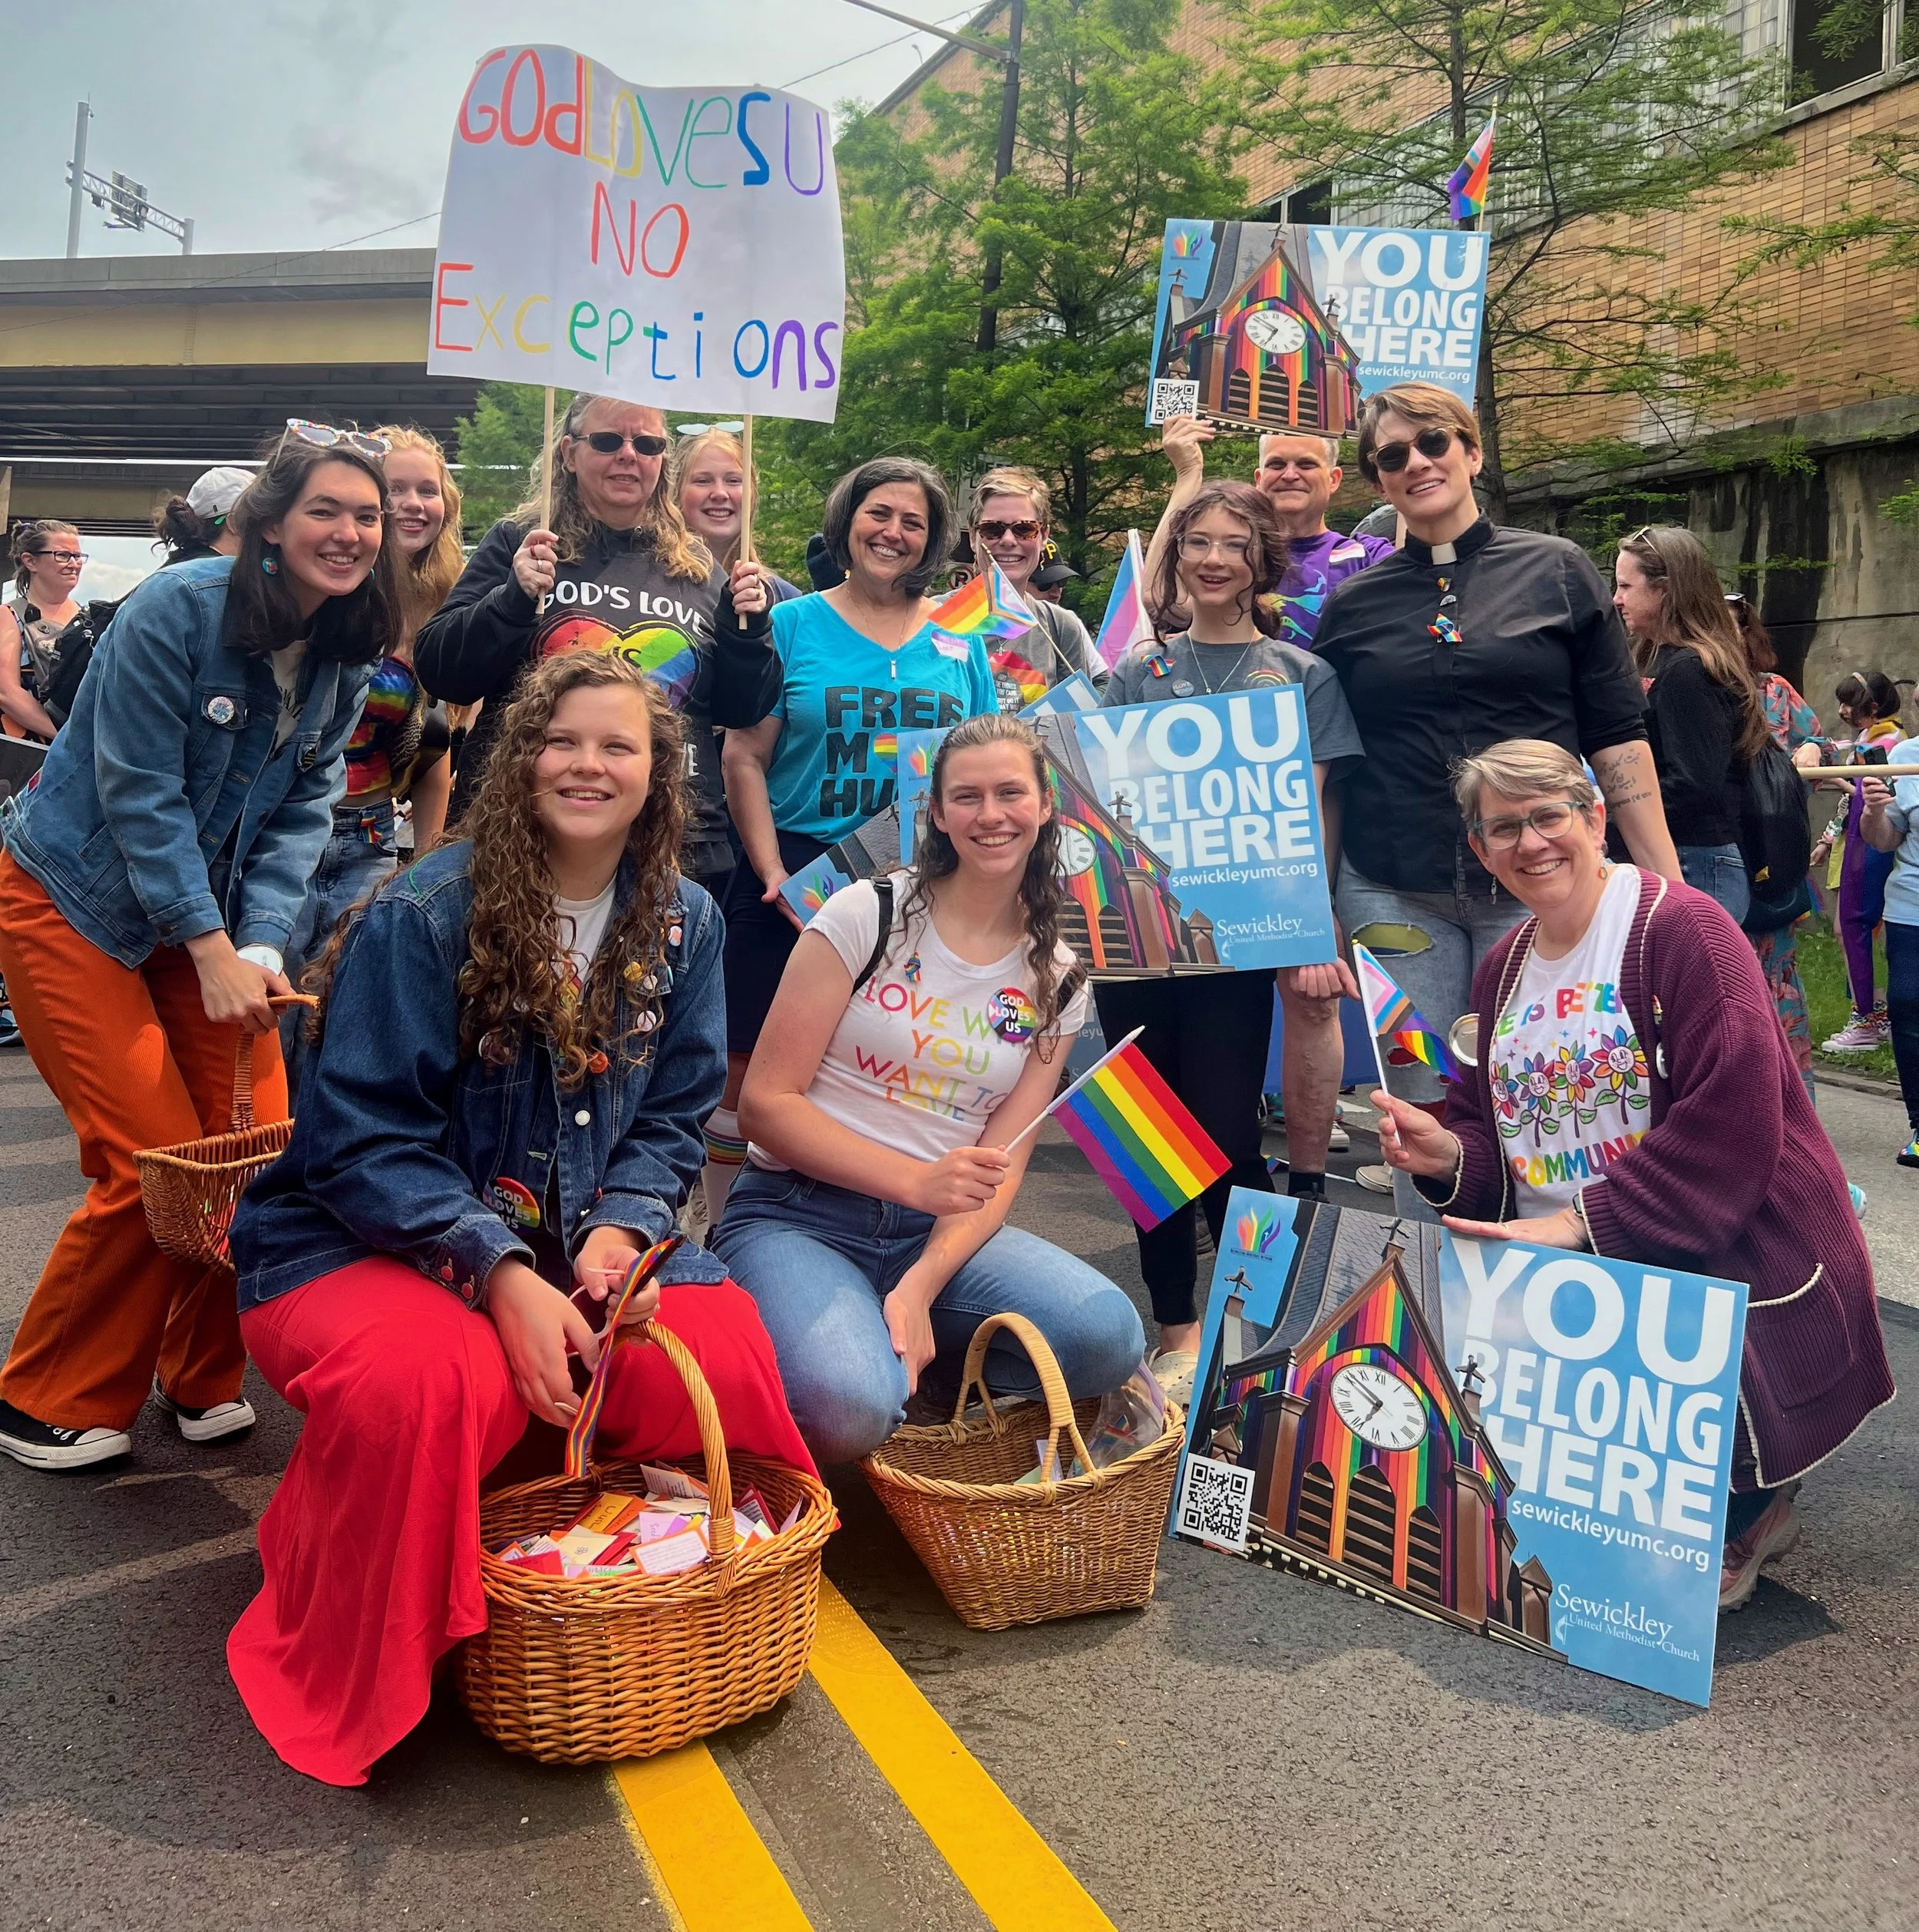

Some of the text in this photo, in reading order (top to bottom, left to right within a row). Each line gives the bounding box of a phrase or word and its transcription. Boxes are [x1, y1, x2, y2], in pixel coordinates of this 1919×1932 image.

[784, 101, 824, 196] U
[590, 180, 690, 279] NO
[1313, 230, 1485, 292] YOU
[434, 262, 839, 391] Exceptions
[1324, 285, 1478, 330] BELONG
[1343, 325, 1473, 368] HERE
[1358, 365, 1471, 384] sewickleyumc.org
[1046, 543, 1057, 560] P
[954, 571, 969, 587] P
[1082, 690, 1300, 779] YOU
[1108, 759, 1310, 826] BELONG
[1138, 809, 1316, 870] HERE
[1171, 862, 1318, 887] sewickleyumc.org
[1217, 913, 1303, 937] Sewickley
[1228, 926, 1326, 945] United Methodist Church
[863, 975, 952, 1029] LOVE
[995, 1006, 1031, 1022] LOVES
[999, 993, 1025, 1008] GOD
[911, 1029, 990, 1076] YOU
[1005, 1021, 1022, 1034] US
[855, 1044, 968, 1104] WANT
[488, 1197, 531, 1221] LOVES
[493, 1186, 524, 1204] GOD
[1449, 1236, 1736, 1386] YOU
[1458, 1338, 1723, 1467] BELONG
[1483, 1413, 1717, 1542] HERE
[1511, 1498, 1710, 1572] sewickleyumc.org
[1555, 1584, 1674, 1645] Sewickley
[1569, 1612, 1700, 1663] United Methodist Church
